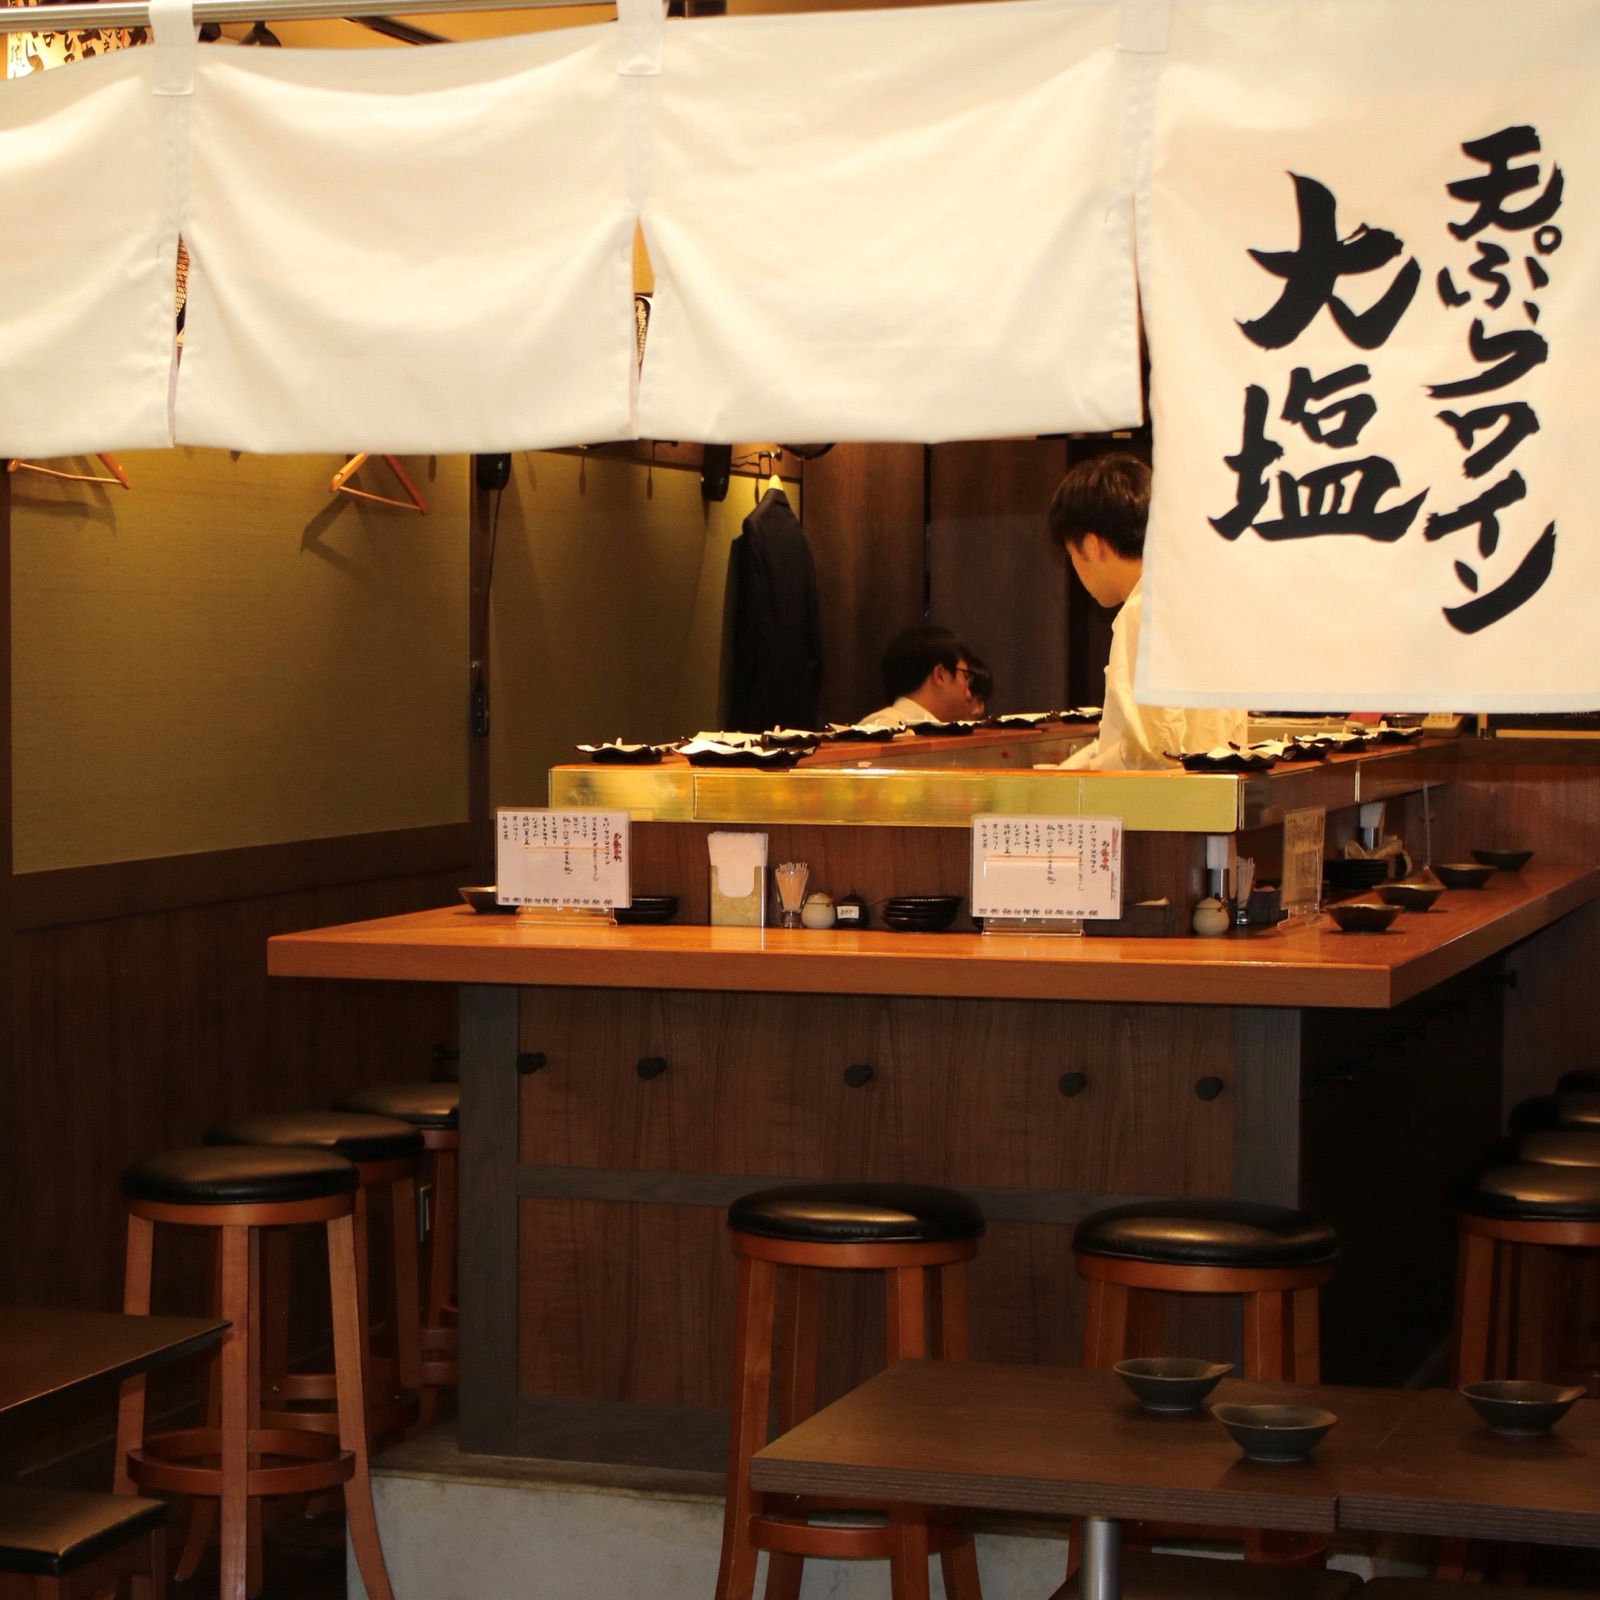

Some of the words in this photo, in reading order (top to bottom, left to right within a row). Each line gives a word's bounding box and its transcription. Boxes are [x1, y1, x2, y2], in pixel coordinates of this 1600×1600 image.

[1207, 170, 1430, 542] 大塩
[1420, 124, 1564, 635] 天ぷらワイン
